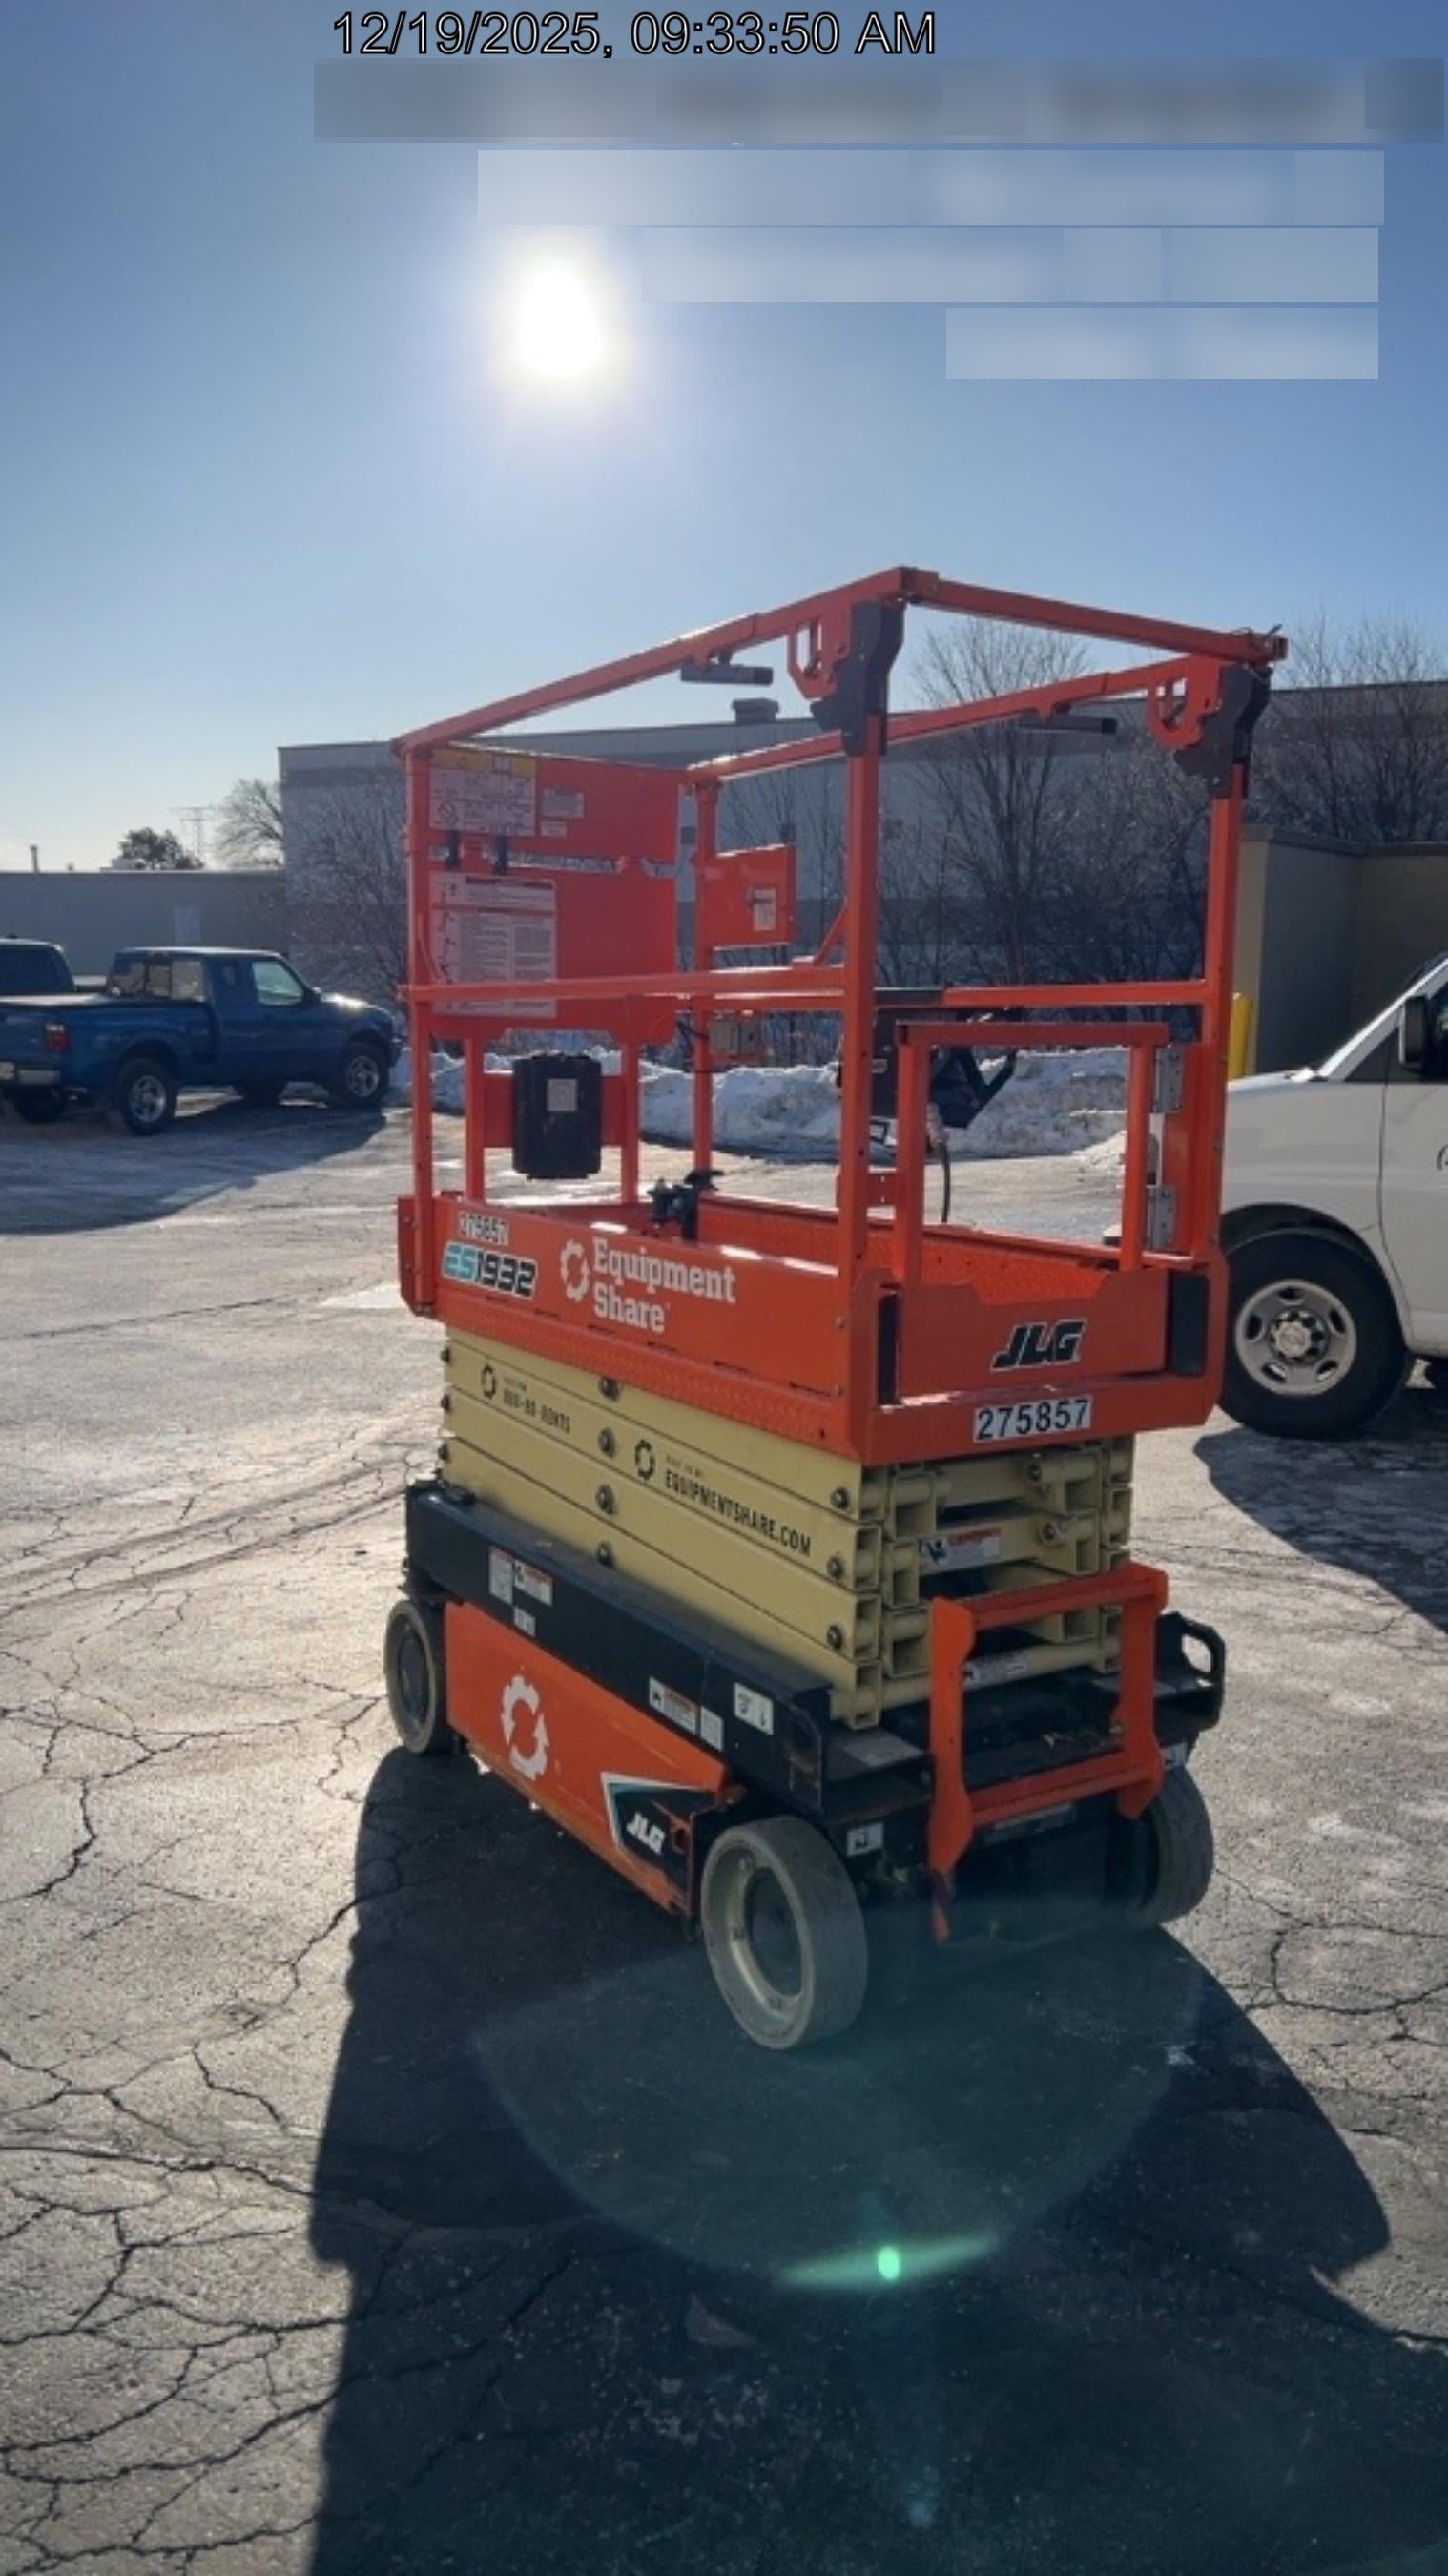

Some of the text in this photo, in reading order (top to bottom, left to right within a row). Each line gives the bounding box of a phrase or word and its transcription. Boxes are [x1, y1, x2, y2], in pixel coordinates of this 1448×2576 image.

[442, 1241, 537, 1300] ES1932
[592, 1237, 736, 1304] Equipment
[593, 1281, 666, 1333] Share
[989, 1319, 1088, 1373] JLG
[976, 1397, 1089, 1441] 275857
[665, 1469, 812, 1557] EQUIPMENTSHARE.COM
[626, 1811, 666, 1855] JLG
